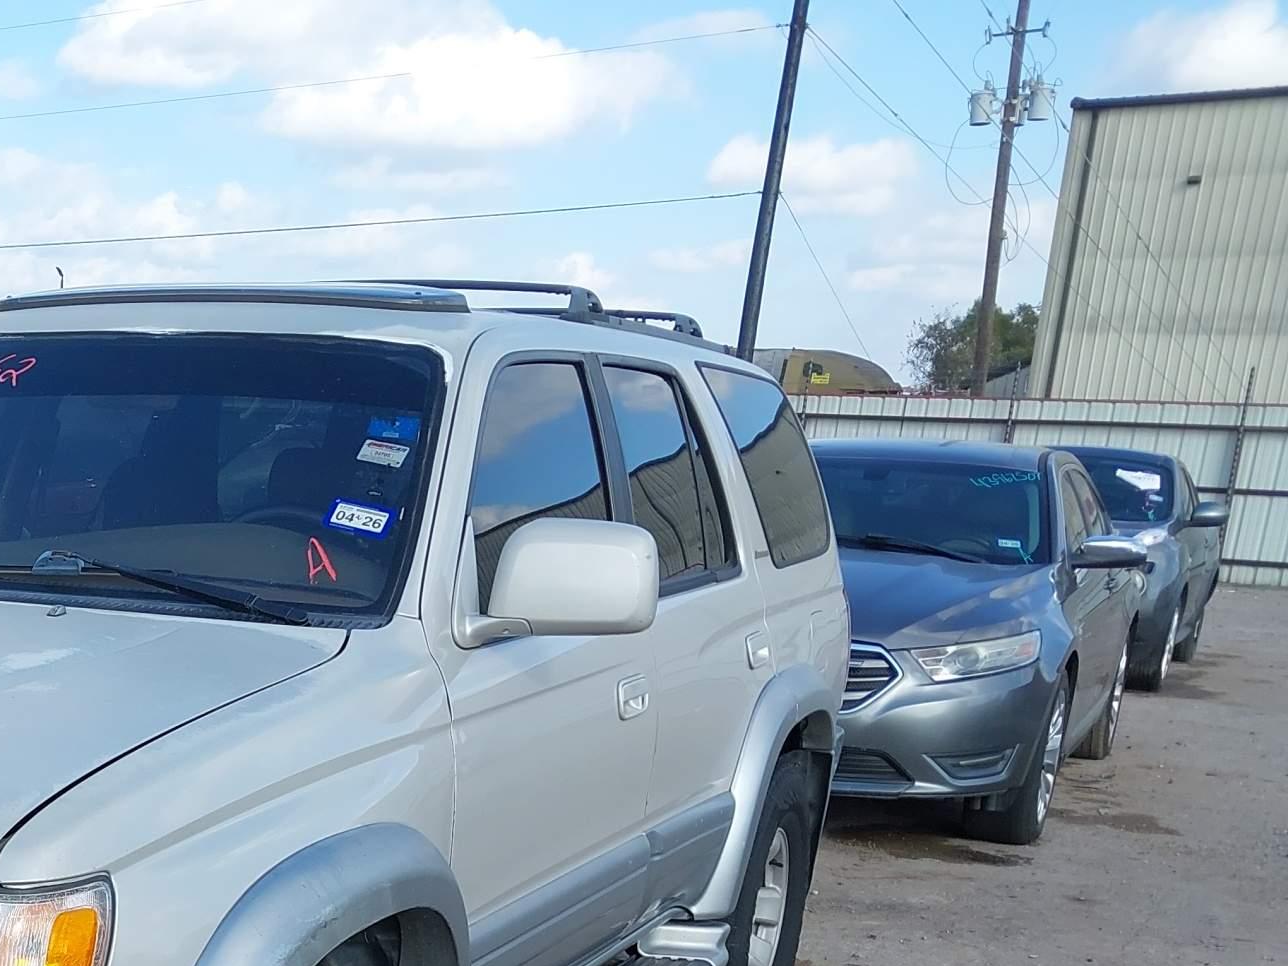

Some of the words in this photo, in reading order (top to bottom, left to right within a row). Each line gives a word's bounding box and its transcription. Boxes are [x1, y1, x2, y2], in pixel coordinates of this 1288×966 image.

[335, 510, 355, 523] 04
[361, 516, 383, 529] 26
[307, 537, 338, 585] A
